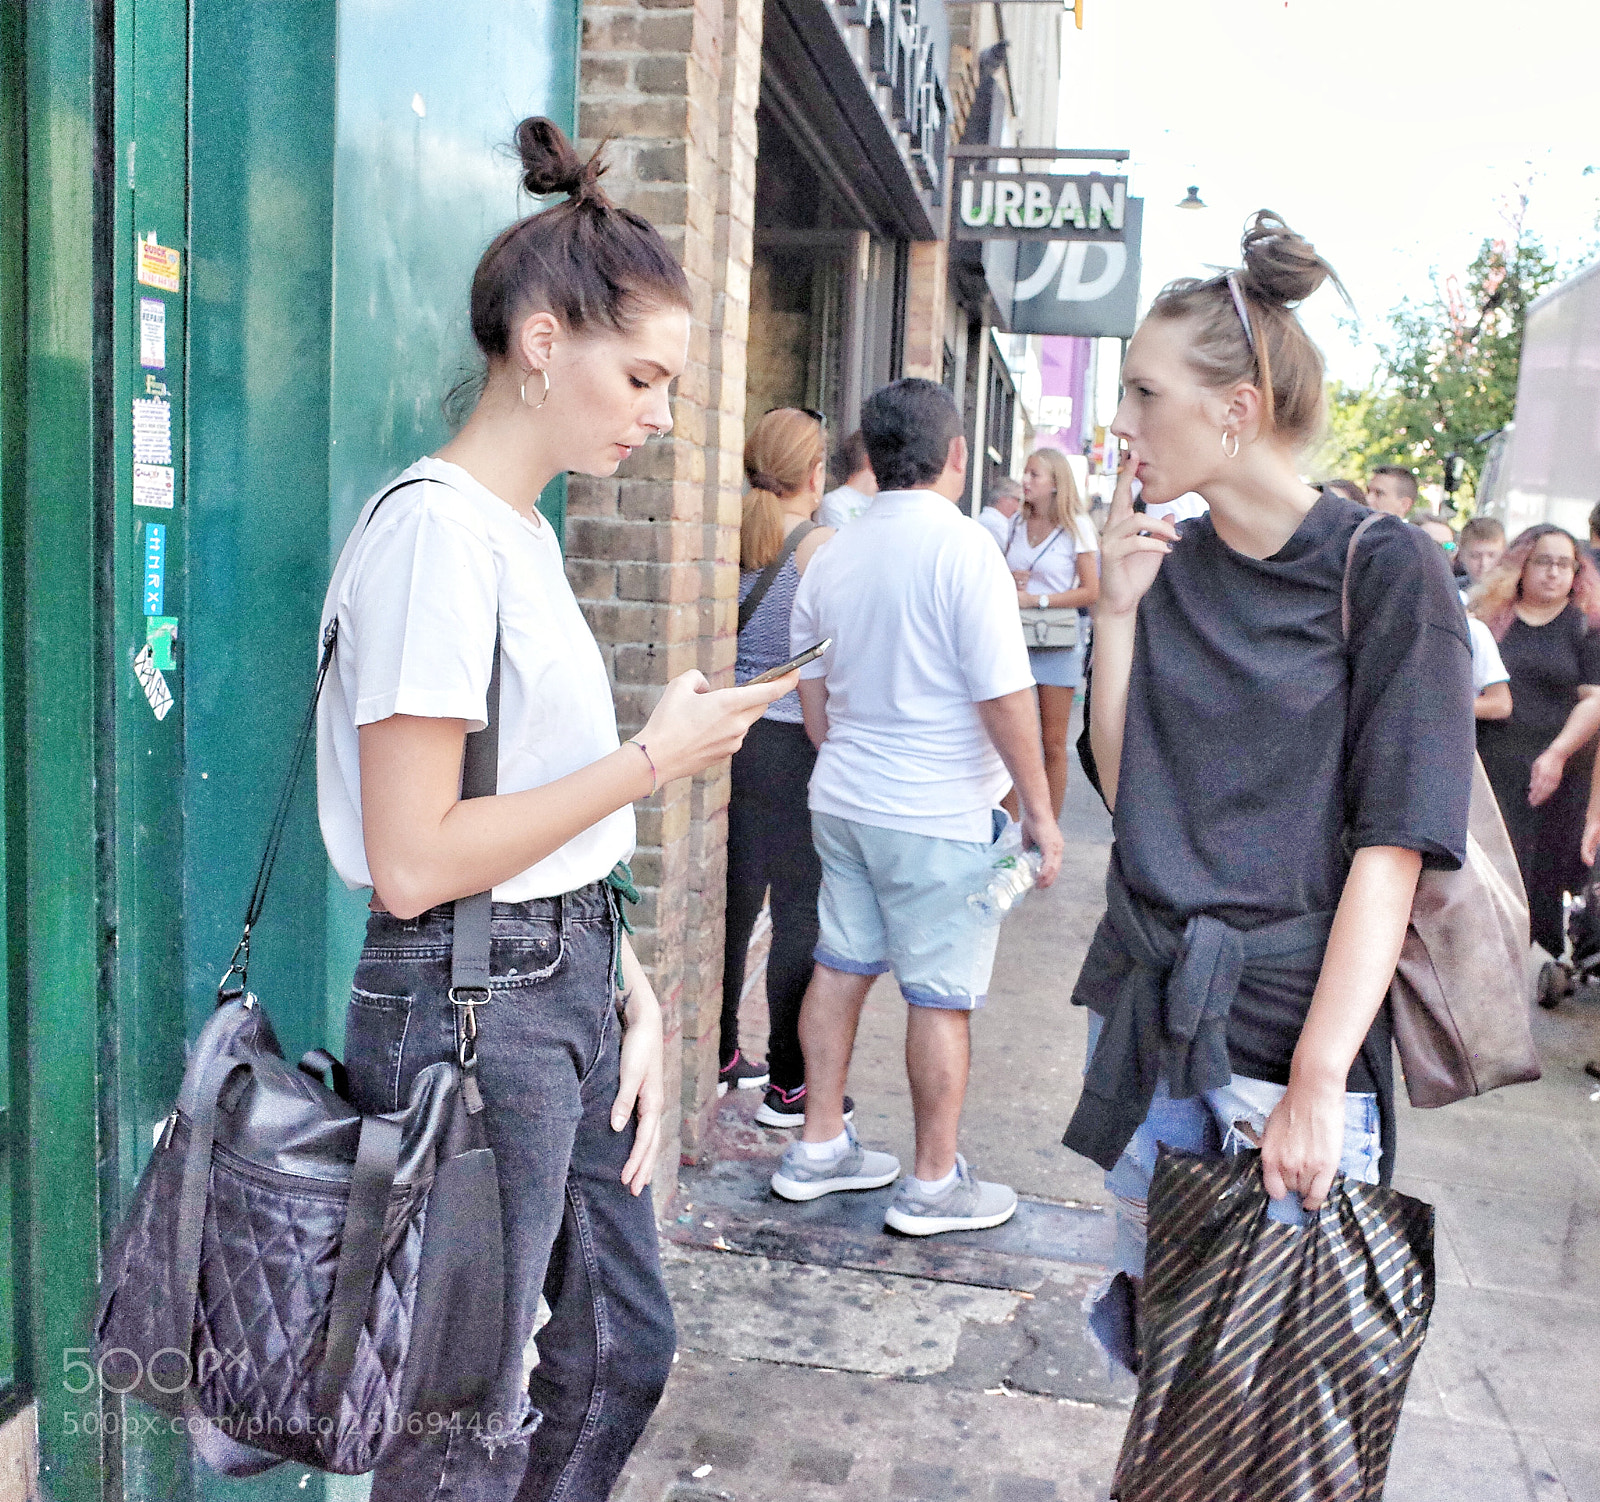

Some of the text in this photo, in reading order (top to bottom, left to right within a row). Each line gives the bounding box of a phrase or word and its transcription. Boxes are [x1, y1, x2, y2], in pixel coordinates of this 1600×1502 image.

[960, 180, 1125, 230] URBAN
[144, 244, 167, 258] QUICK
[142, 312, 165, 323] REPAIR
